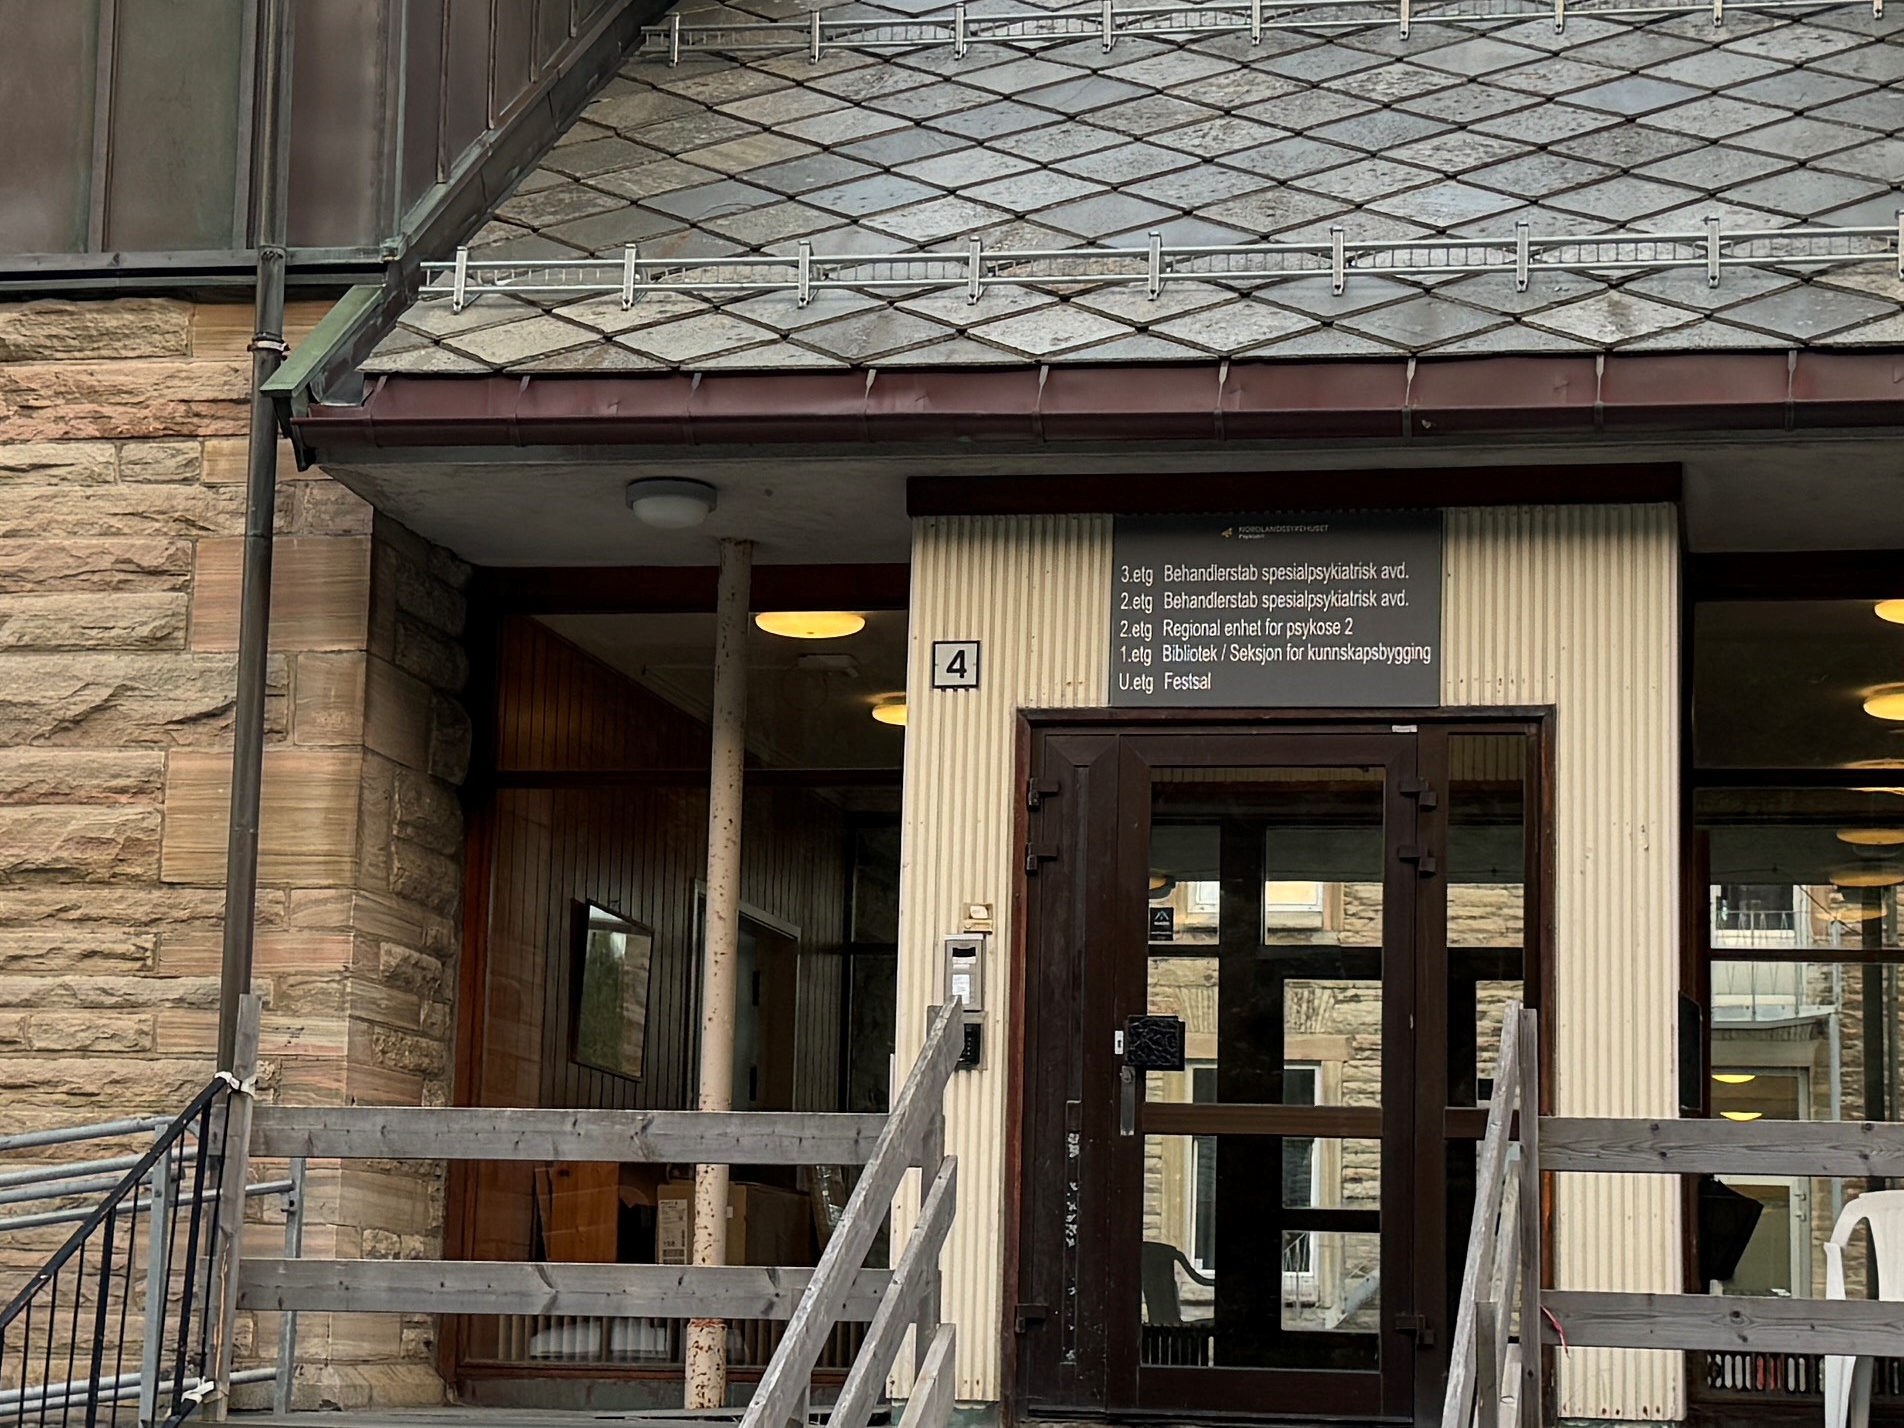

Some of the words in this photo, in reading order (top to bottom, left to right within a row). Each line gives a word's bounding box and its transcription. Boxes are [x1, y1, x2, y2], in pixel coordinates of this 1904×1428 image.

[1120, 565, 1154, 586] 3.etg
[1164, 564, 1258, 582] Behandlerstab
[1261, 562, 1377, 585] spesialpsykiatrisk
[1381, 562, 1409, 580] avd.
[1120, 592, 1153, 614] 2.etg
[1164, 591, 1258, 609] Behandlerstab
[1261, 589, 1377, 612] spesialpsykiatrisk
[1381, 589, 1409, 607] avd.
[1119, 620, 1153, 642] 2.etg
[1162, 619, 1221, 641] Regional
[1224, 619, 1262, 637] enhet
[1265, 618, 1283, 636] for
[1286, 618, 1341, 640] psykose
[1344, 617, 1353, 635] 2
[946, 649, 967, 679] 4
[1119, 645, 1152, 667] 1.etg
[1162, 644, 1218, 662] Bibliotek
[1221, 644, 1227, 661] /
[1229, 643, 1283, 665] Seksjon
[1286, 643, 1304, 661] for
[1307, 642, 1431, 665] kunnskapsbygging
[1119, 673, 1154, 694] U.etg
[1164, 672, 1212, 690] Festsal
